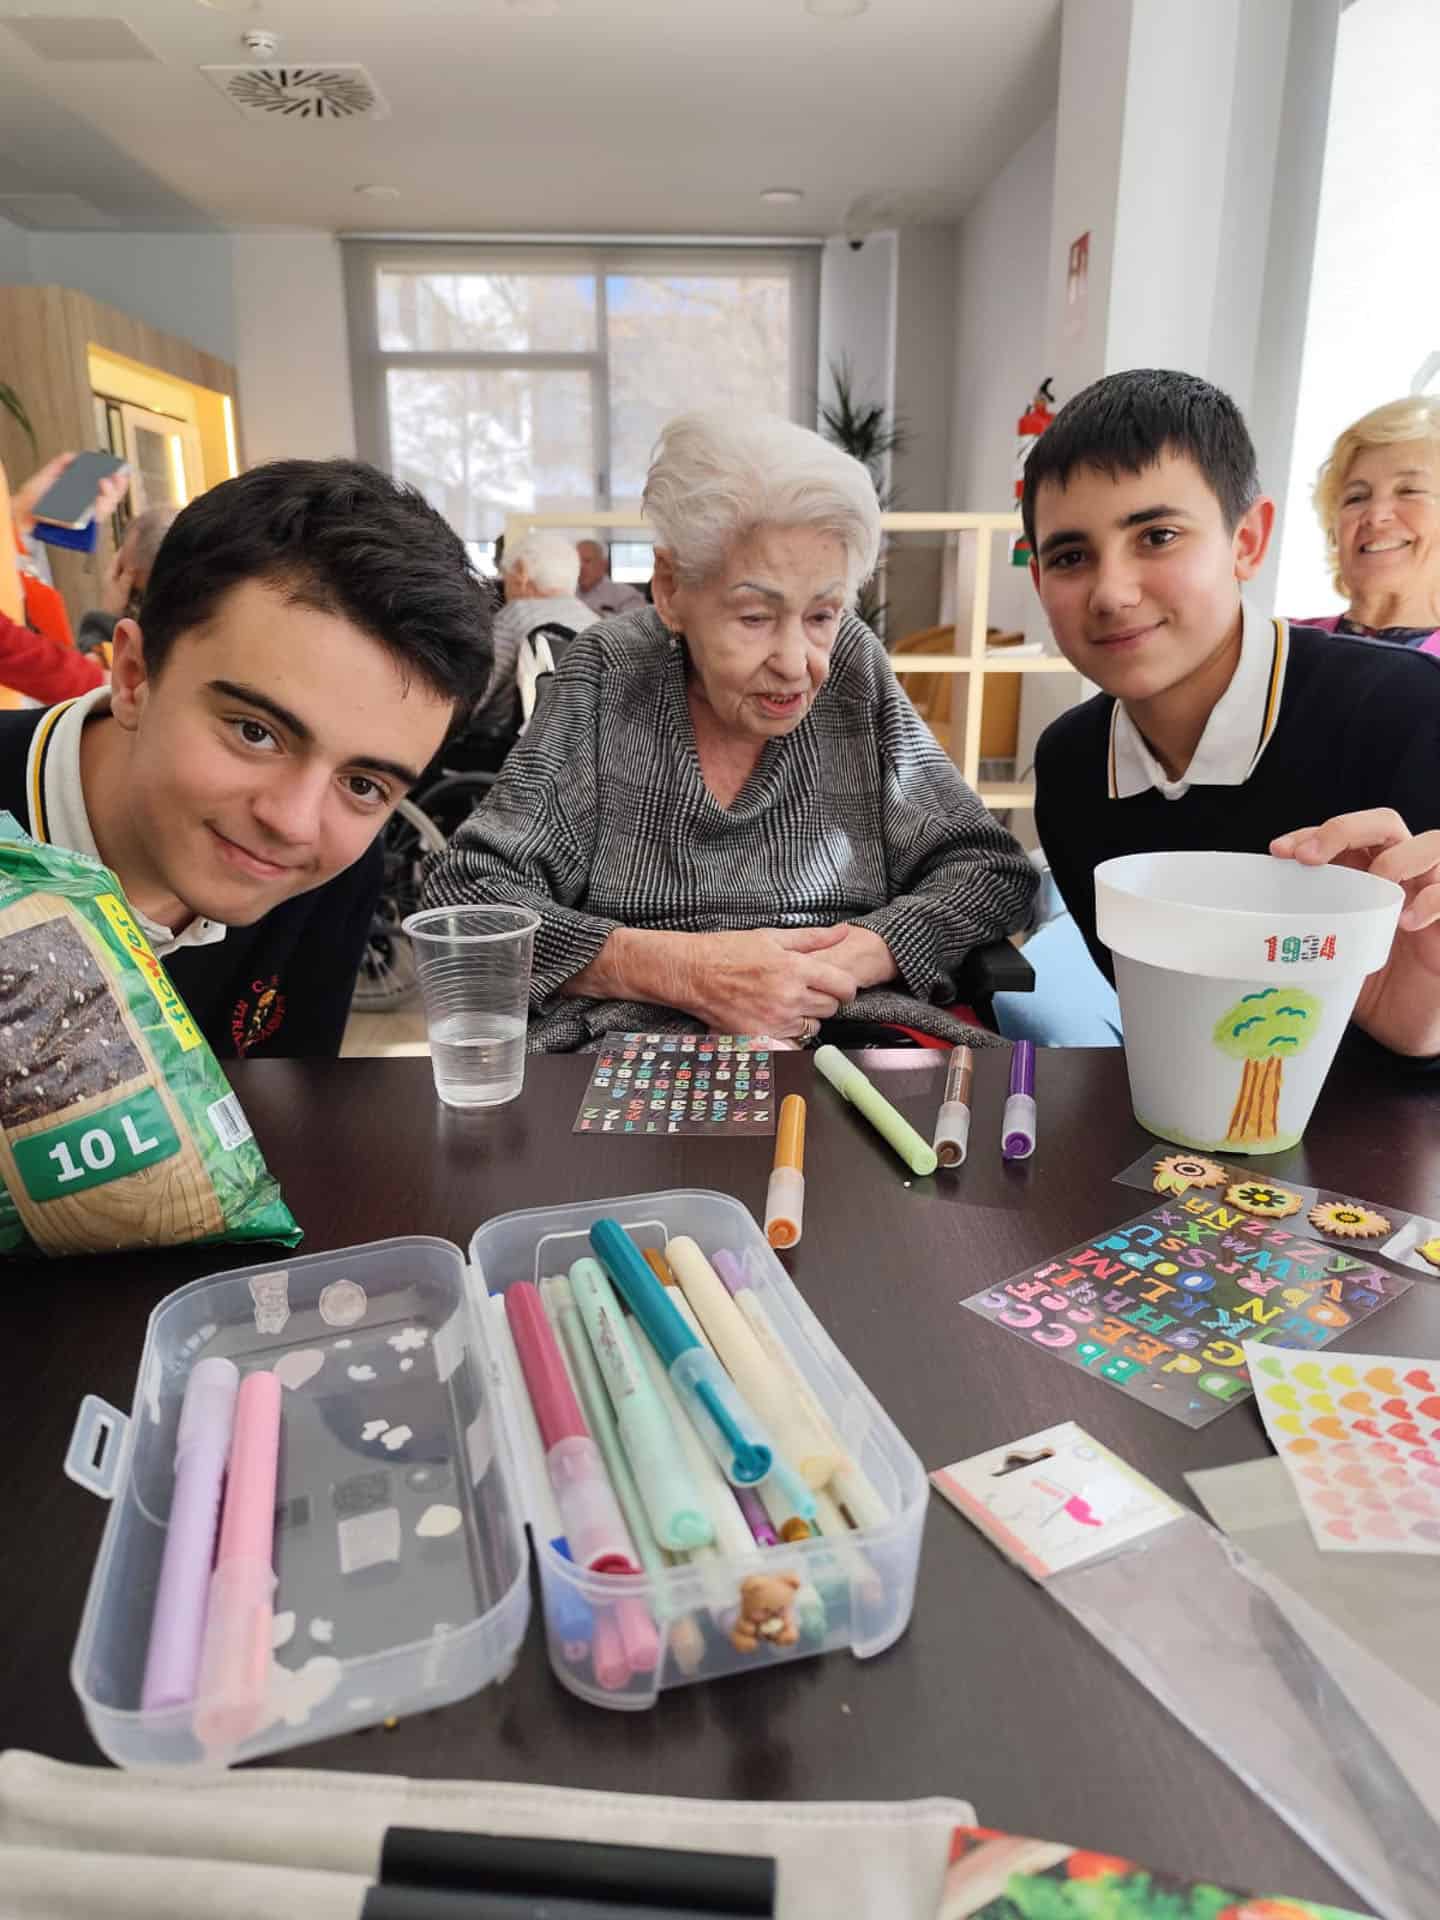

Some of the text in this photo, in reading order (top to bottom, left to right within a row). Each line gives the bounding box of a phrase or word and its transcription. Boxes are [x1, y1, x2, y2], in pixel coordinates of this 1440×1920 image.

[1264, 934, 1337, 962] 1934
[49, 1128, 117, 1183] 10
[120, 1114, 160, 1156] L
